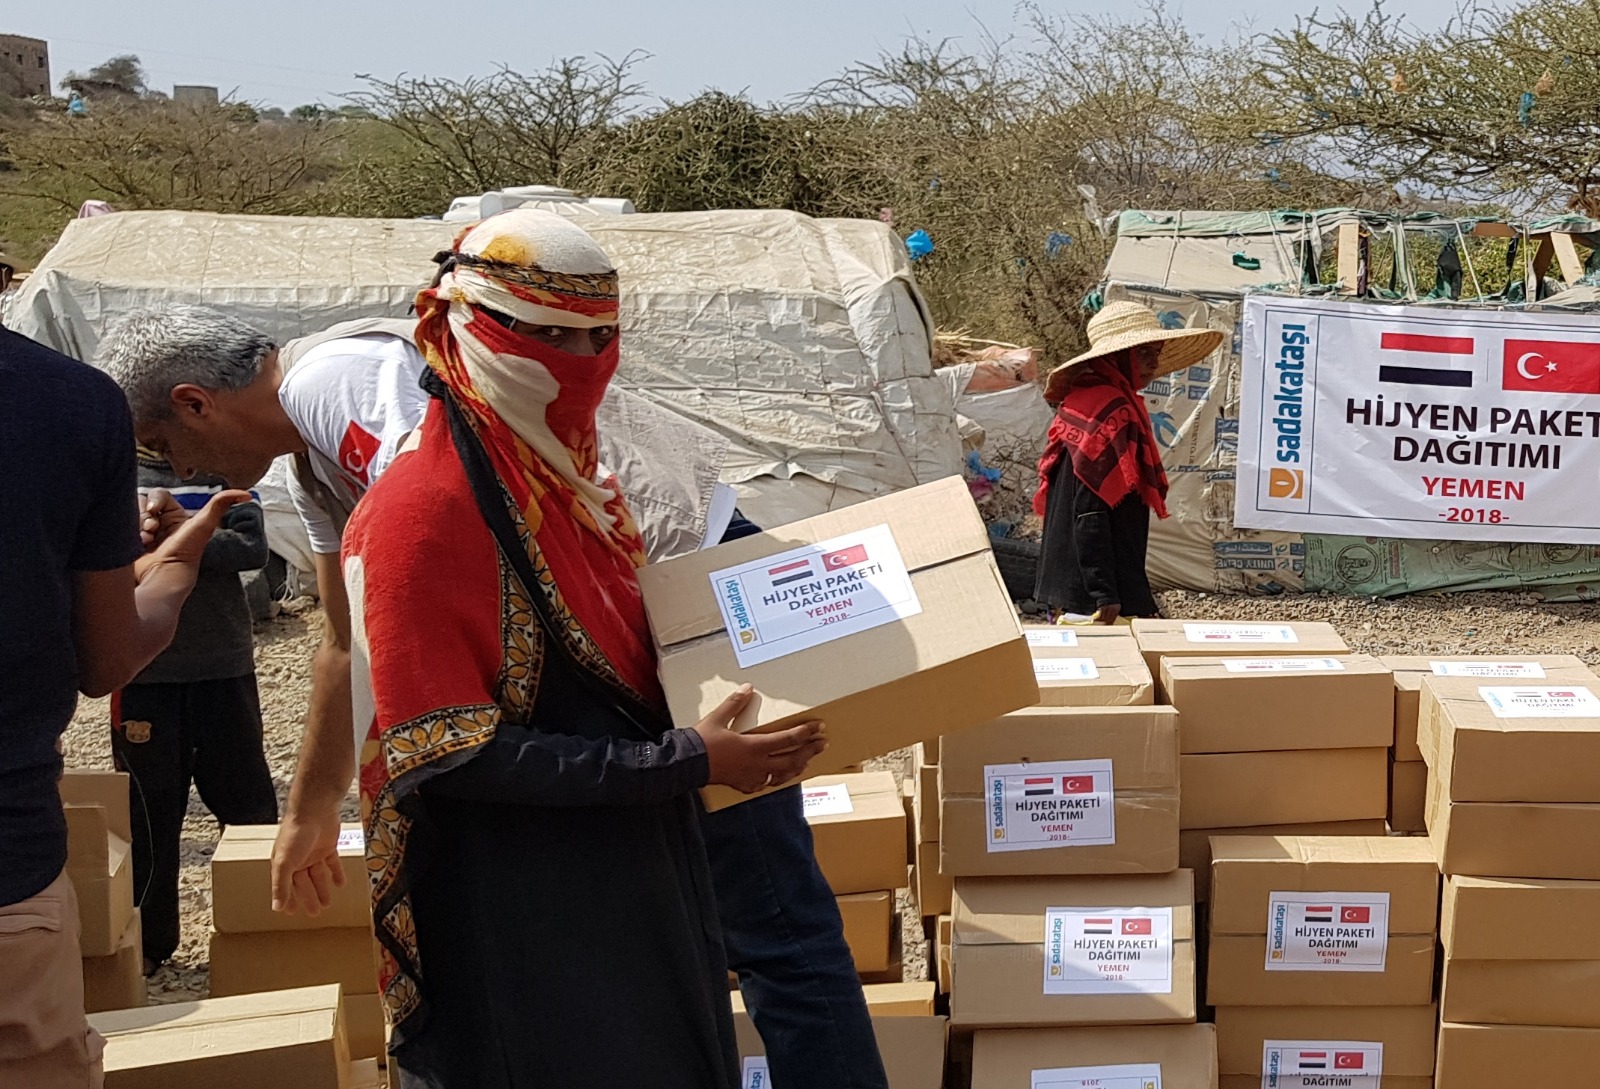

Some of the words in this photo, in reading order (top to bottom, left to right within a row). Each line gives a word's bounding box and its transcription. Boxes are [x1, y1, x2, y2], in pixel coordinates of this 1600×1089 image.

[1274, 324, 1309, 463] sadakataşı
[1346, 394, 1478, 432] HİJYEN
[1490, 407, 1600, 438] PAKET
[1393, 434, 1560, 469] DAĞITIMI
[1422, 476, 1525, 500] YEMEN
[1438, 508, 1510, 524] -2018-
[763, 581, 822, 606] HİJYEN
[827, 562, 884, 588] PAKETİ
[789, 582, 864, 611] DAĞITIMI
[806, 599, 853, 619] YEMEN
[1015, 799, 1057, 811] HİJYEN
[1060, 797, 1101, 809] PAKETİ
[1031, 810, 1084, 822] DAĞITIMI
[1041, 823, 1073, 832] YEMEN
[1295, 925, 1334, 938] HİJYEN
[1337, 927, 1374, 938] PAKETİ
[1073, 938, 1114, 949] HİJYEN
[1118, 938, 1158, 949] PAKETİ
[1308, 938, 1358, 949] DAĞITIMI
[1088, 949, 1141, 961] DAĞITIMI
[1097, 964, 1130, 972] YEMEN
[1302, 1075, 1352, 1086] DAĞITIMI
